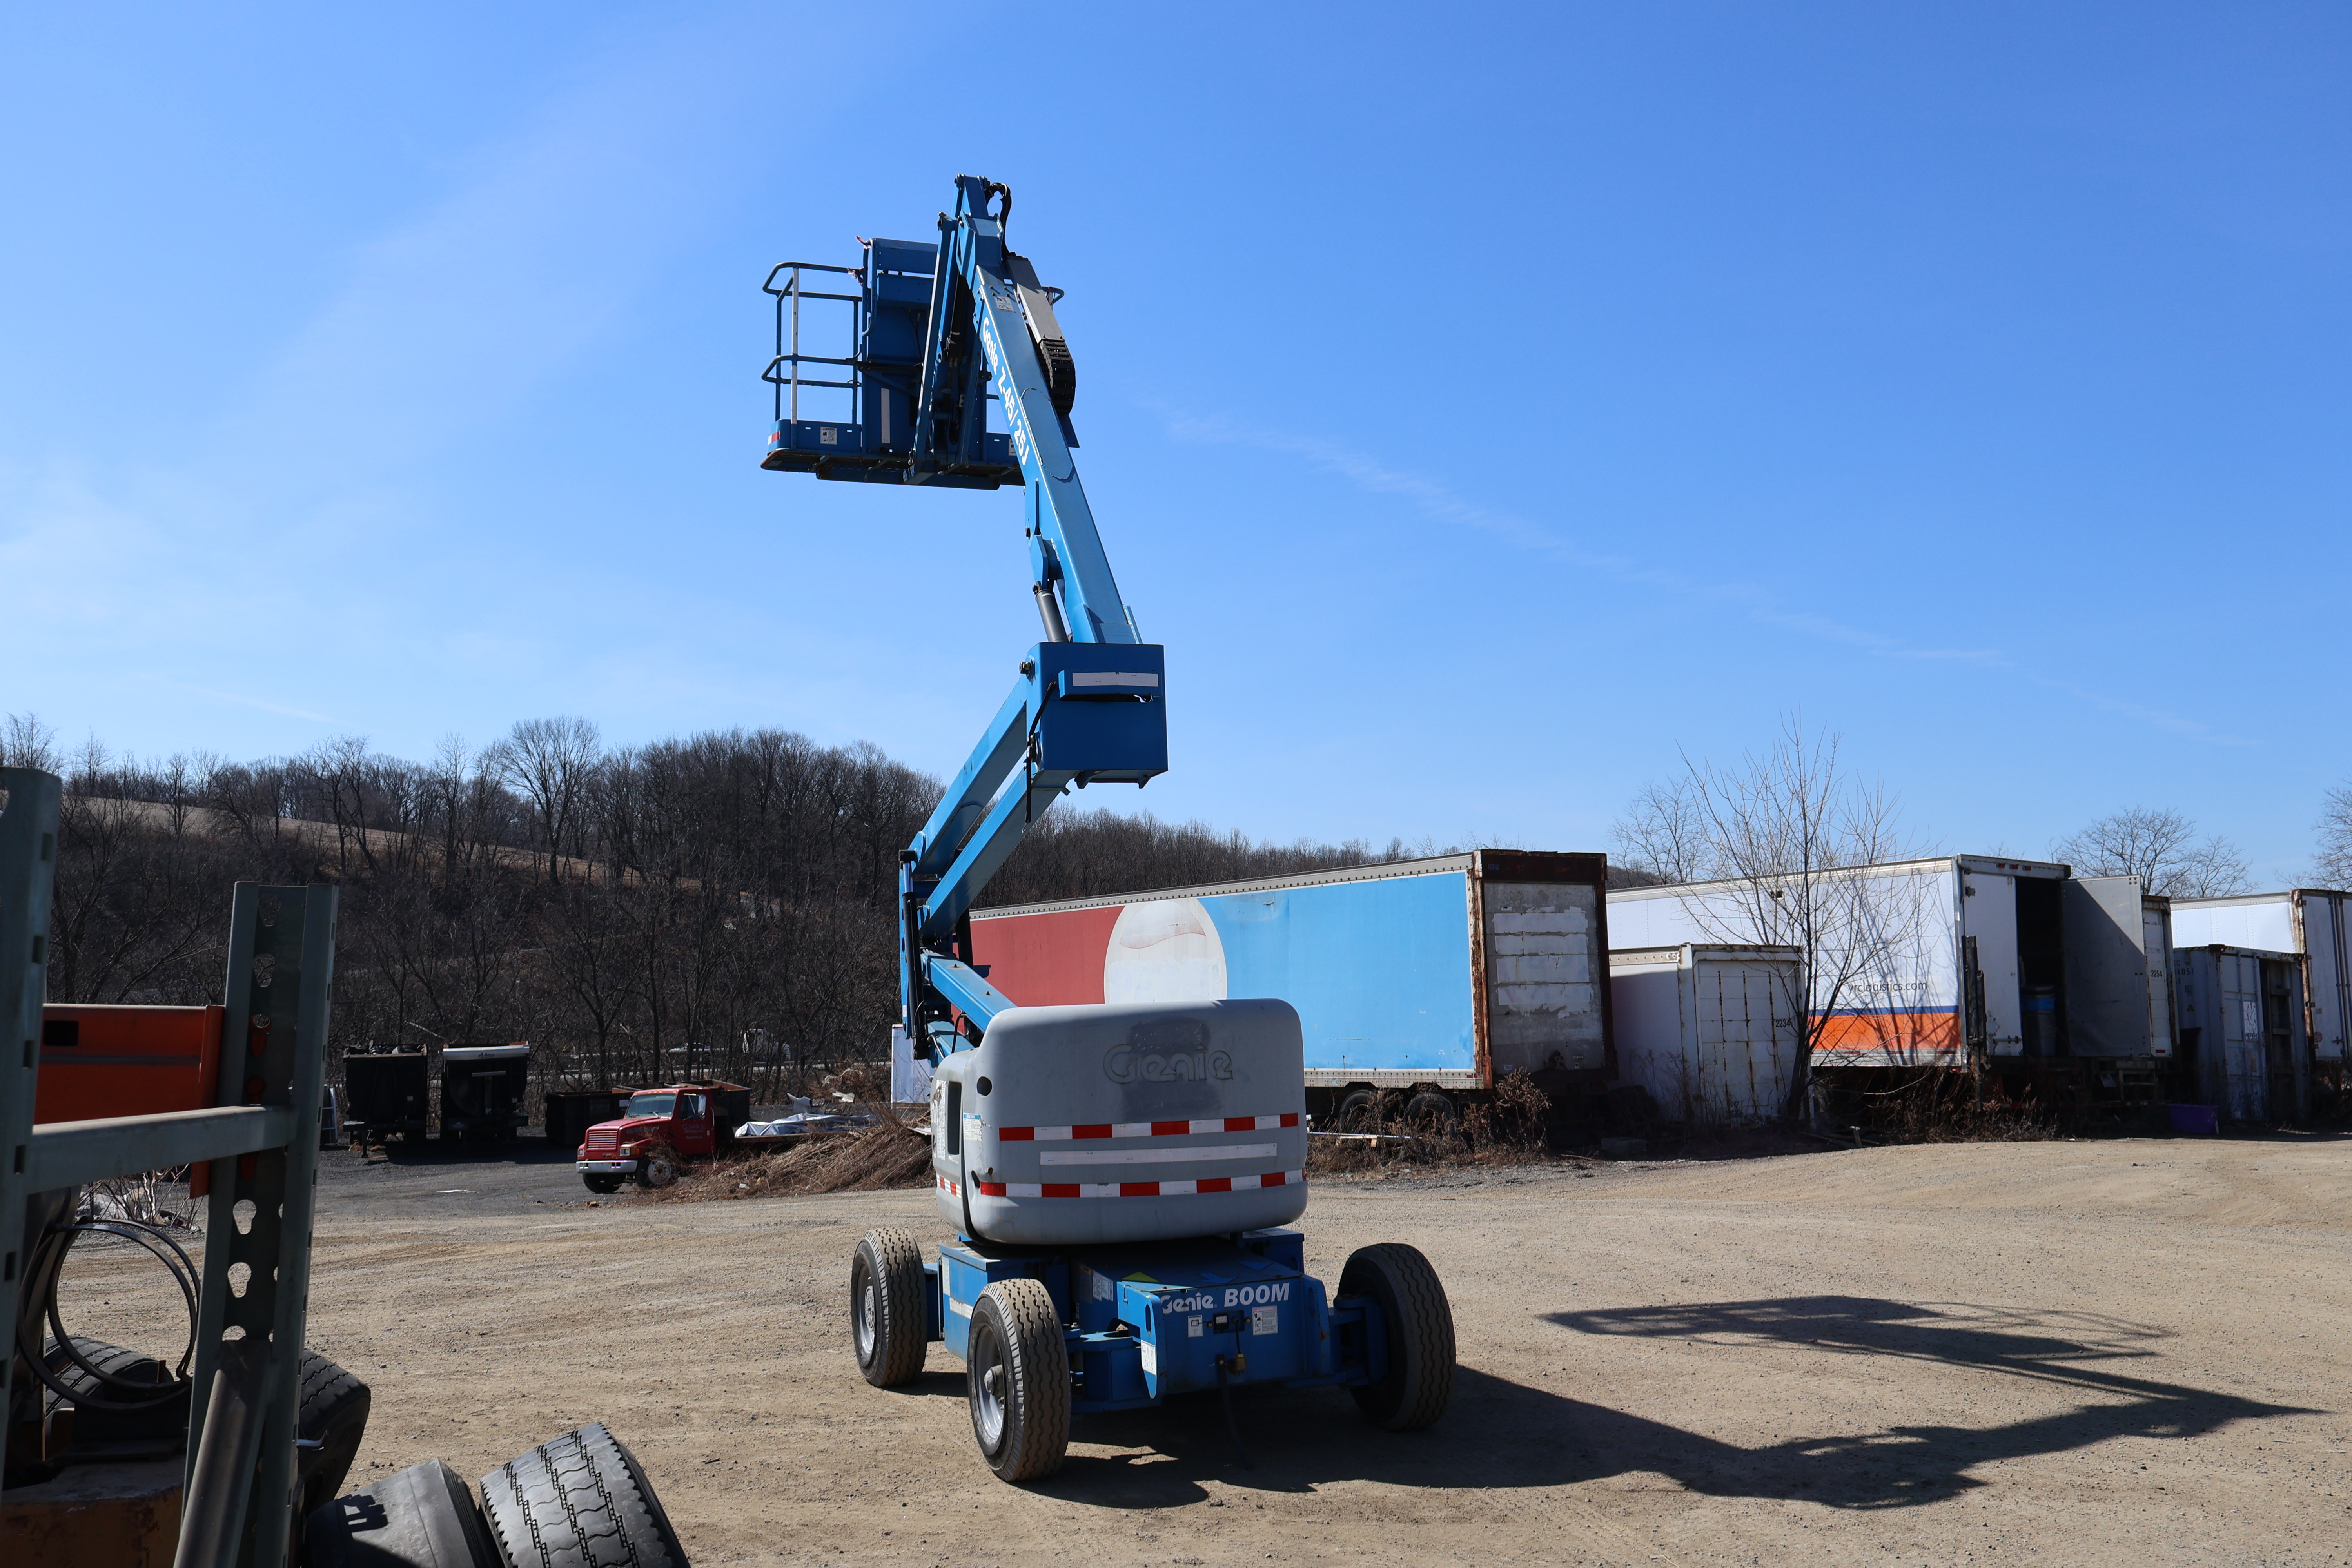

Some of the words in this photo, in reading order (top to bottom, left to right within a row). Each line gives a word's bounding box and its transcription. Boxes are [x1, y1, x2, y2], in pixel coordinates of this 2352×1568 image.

[982, 316, 999, 375] Genie
[2151, 969, 2163, 978] 2254
[1848, 979, 1927, 996] yrclogistics.com
[1775, 1019, 1790, 1027] 2234
[1103, 1043, 1234, 1085] Genie
[1160, 1291, 1214, 1314] Genie
[1224, 1282, 1290, 1308] BOOM
